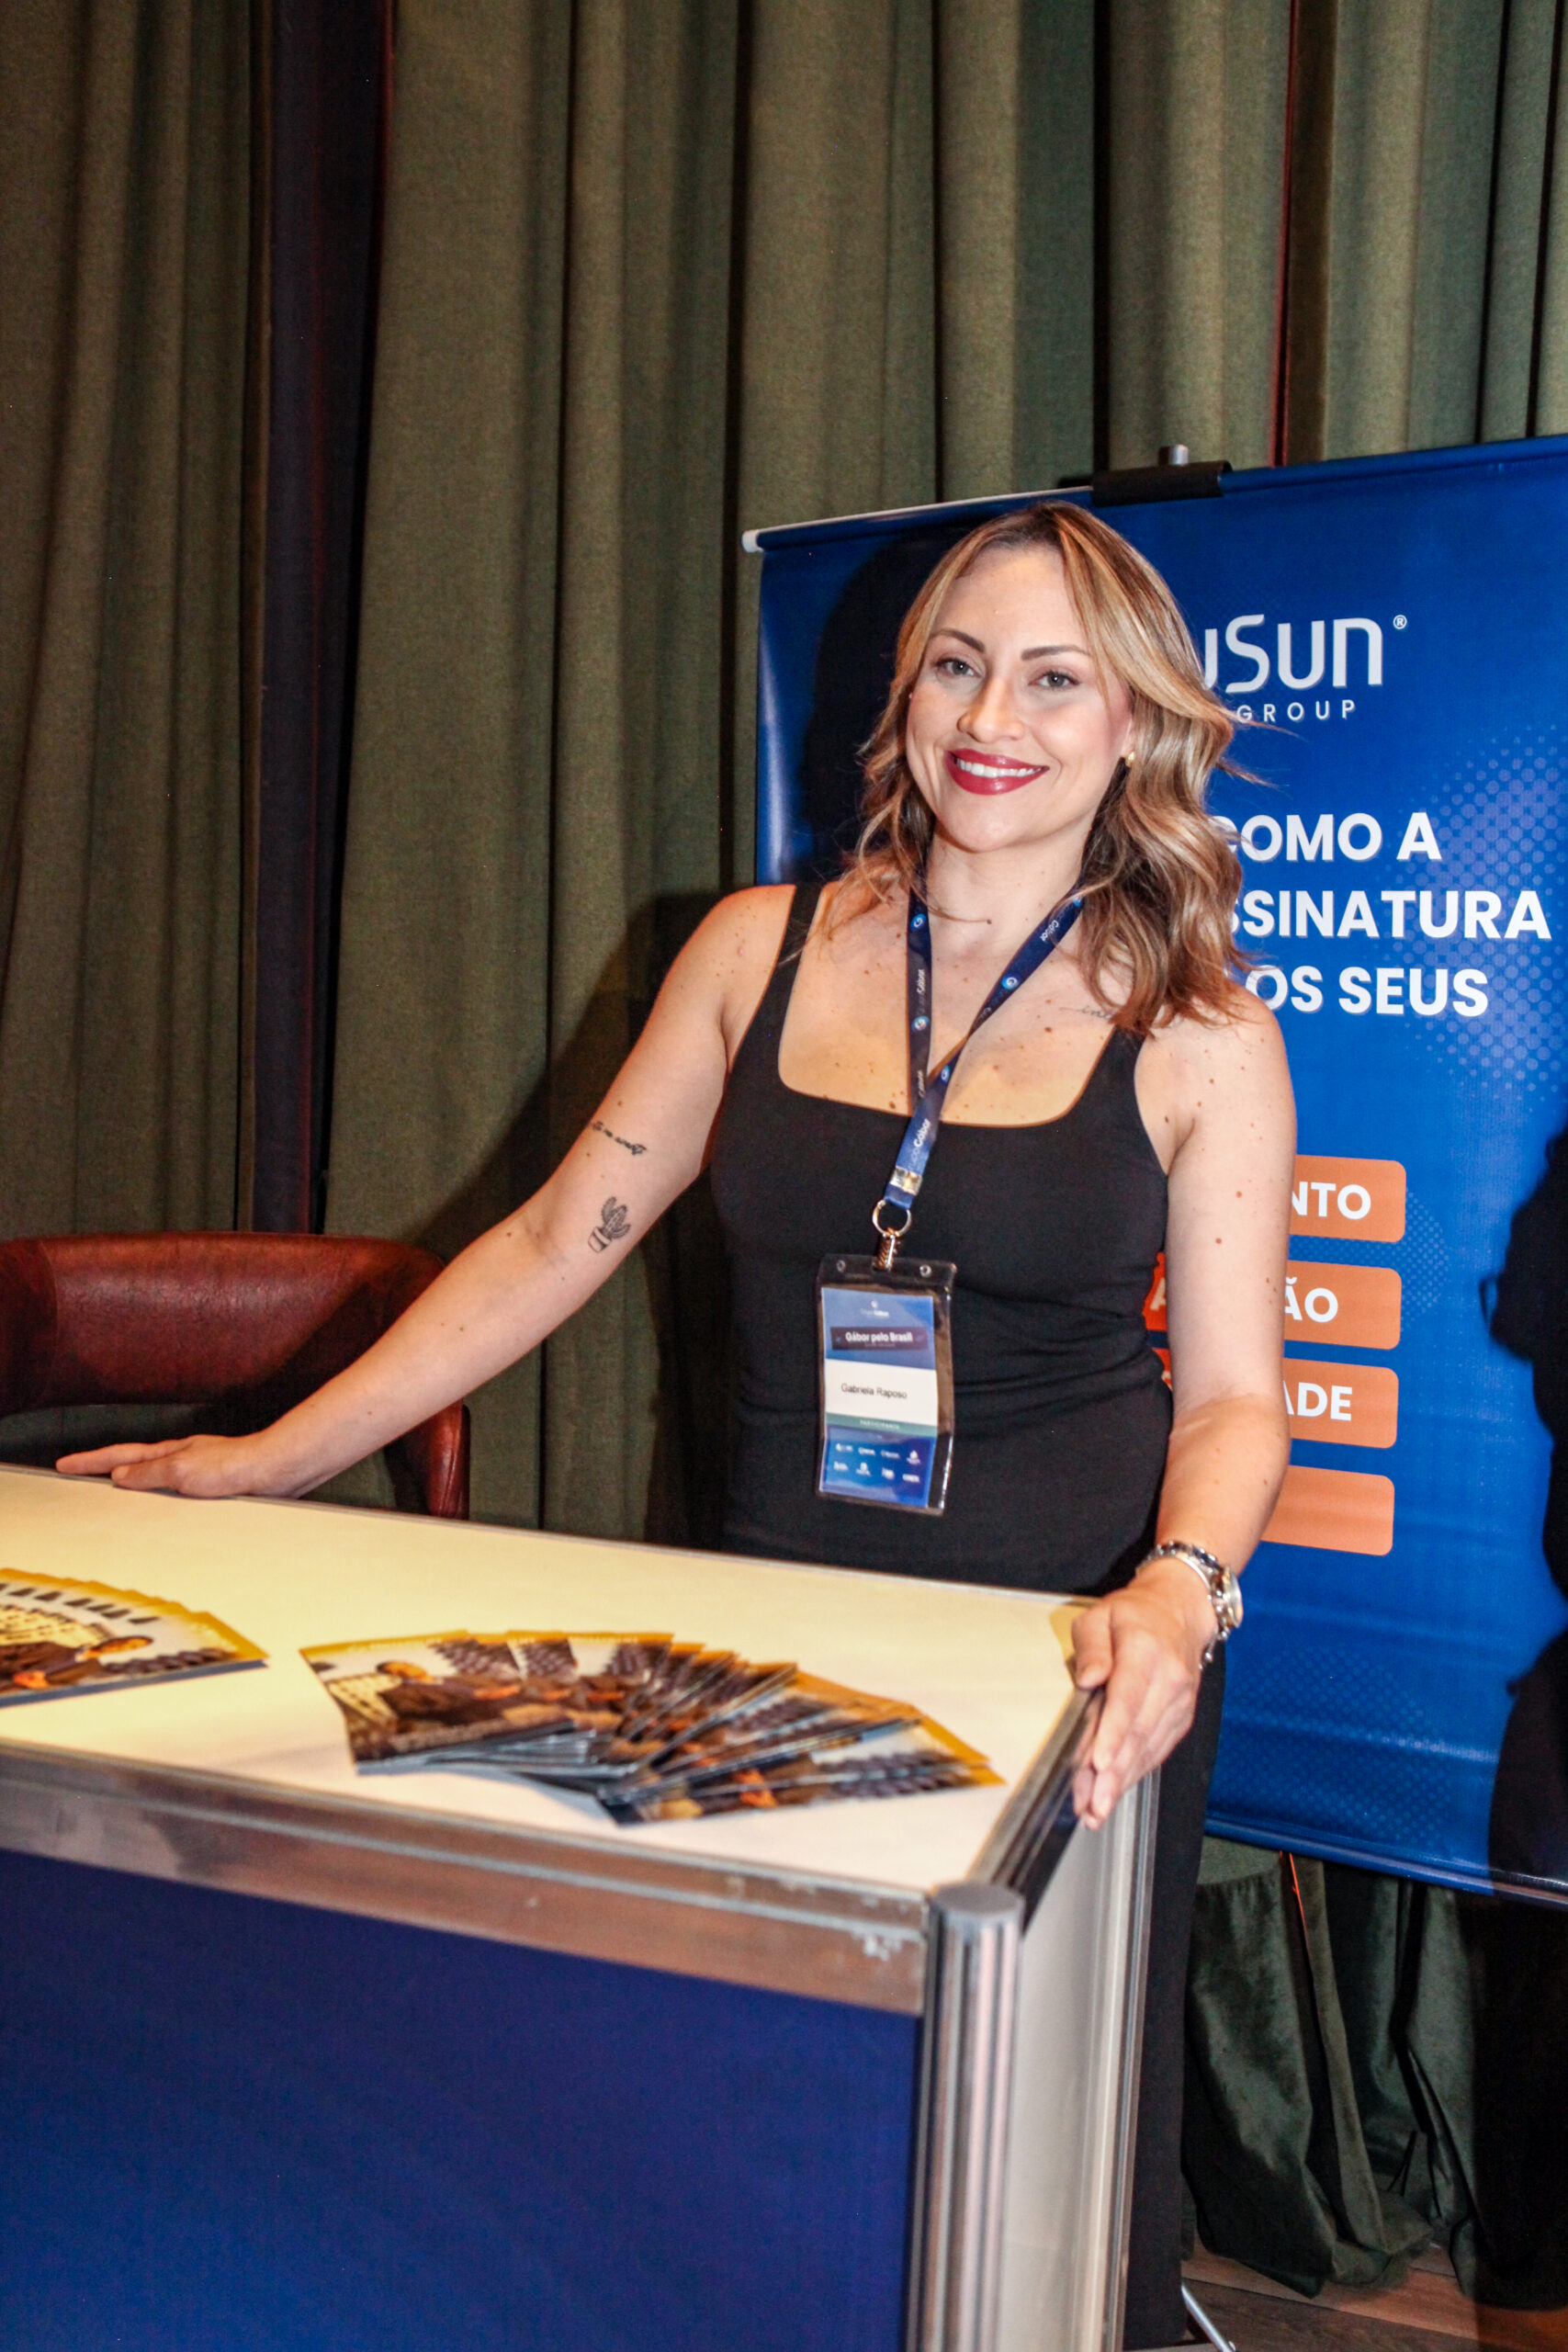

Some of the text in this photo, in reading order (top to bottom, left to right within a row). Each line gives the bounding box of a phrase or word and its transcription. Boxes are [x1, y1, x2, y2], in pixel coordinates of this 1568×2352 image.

[1236, 699, 1356, 723] GROUP
[1396, 812, 1442, 861] A
[1224, 965, 1489, 1017] OS SEUS
[841, 1383, 908, 1398] Gabriela Raposo
